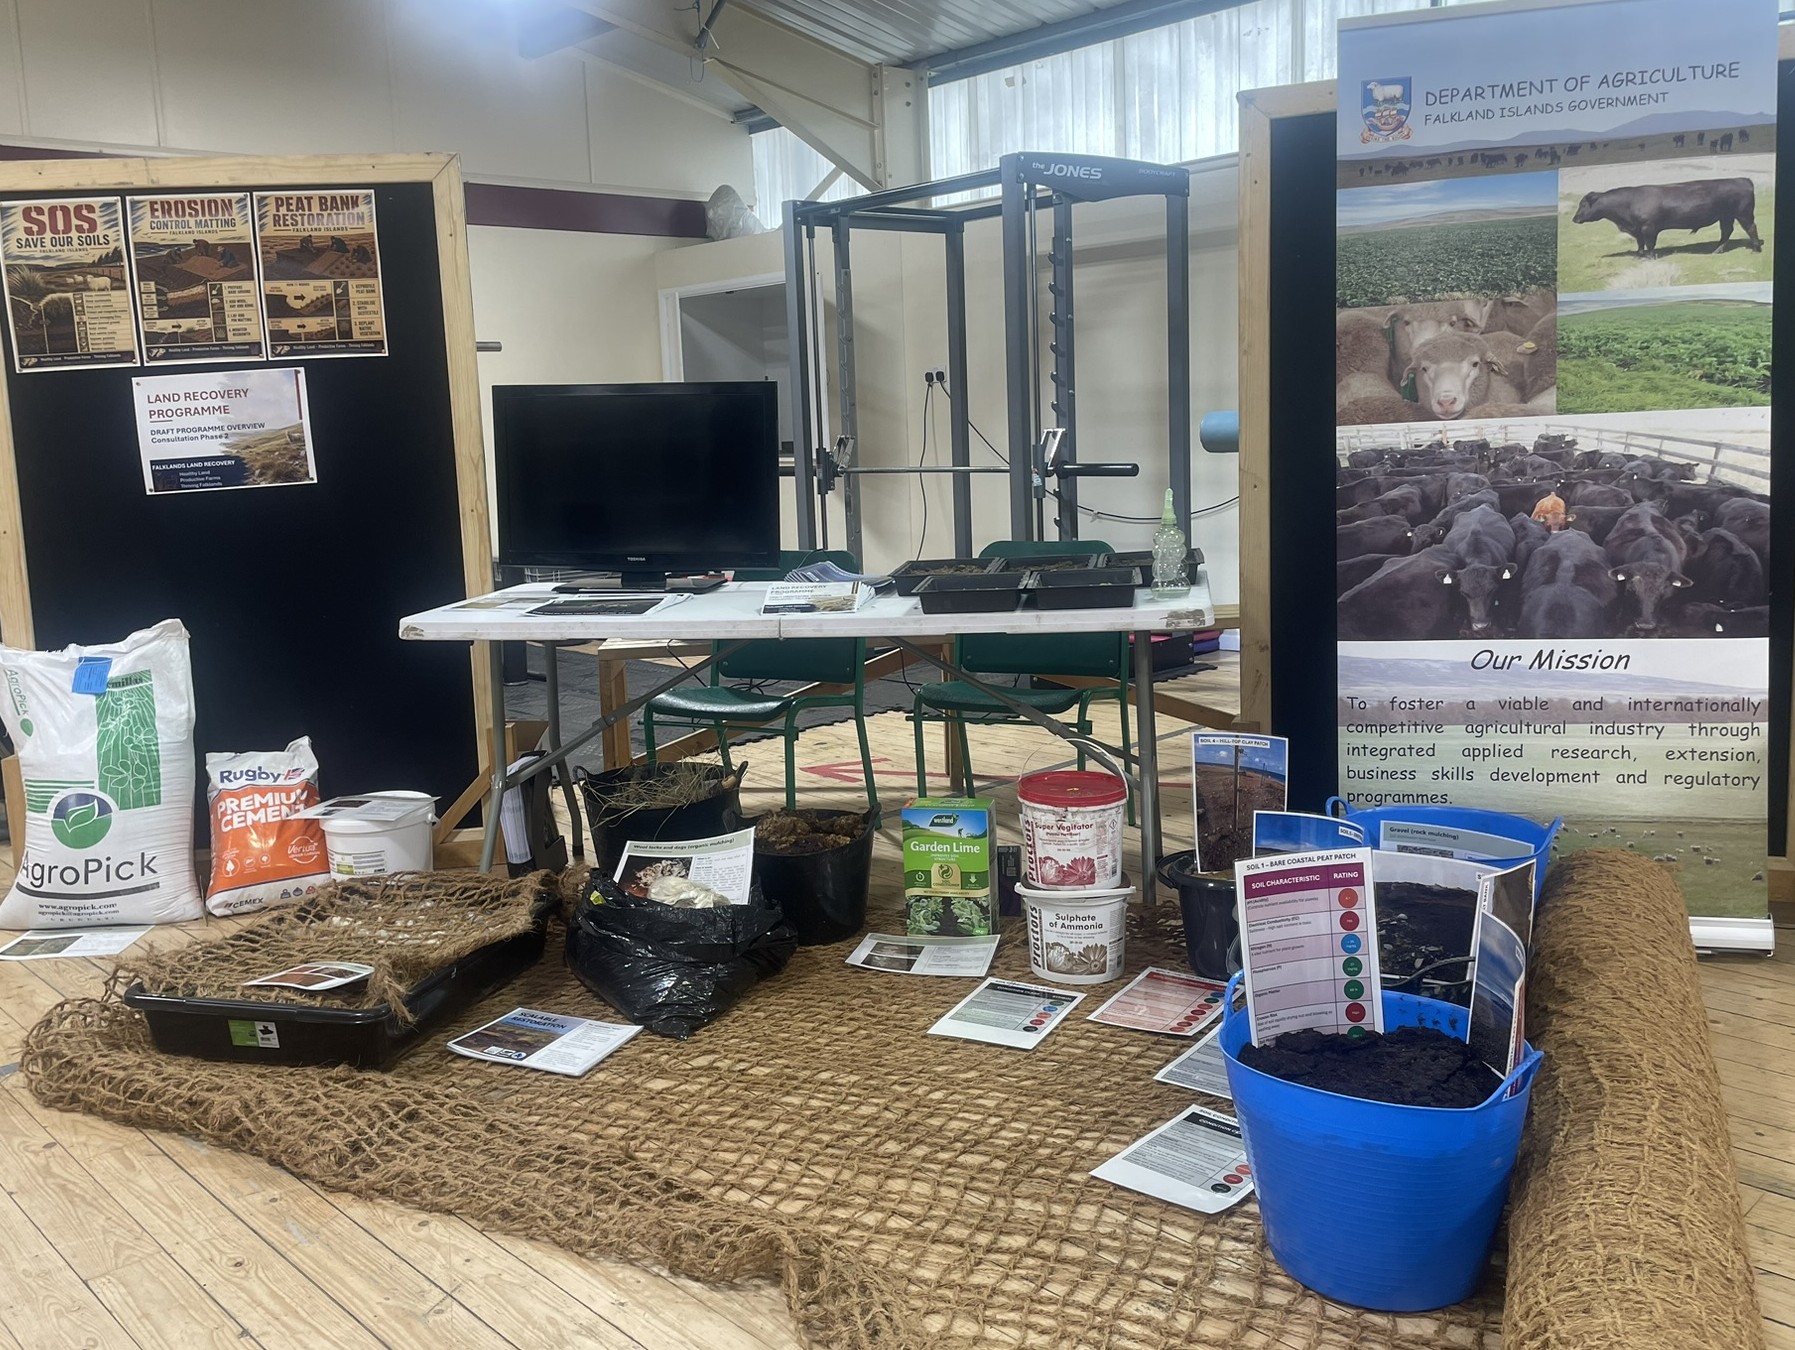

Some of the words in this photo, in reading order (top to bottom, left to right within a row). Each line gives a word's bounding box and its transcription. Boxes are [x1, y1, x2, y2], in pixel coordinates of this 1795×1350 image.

[1425, 78, 1558, 107] DEPARTMENT
[1564, 74, 1591, 92] OF
[1598, 61, 1741, 90] AGRICULTURE
[1424, 108, 1494, 127] FALKLAND
[1500, 102, 1564, 119] ISLANDS
[1568, 92, 1669, 112] GOVERNMENT
[1044, 164, 1102, 179] JONES
[149, 199, 233, 219] EROSION
[275, 197, 313, 212] PEAT
[318, 195, 360, 212] BANK
[22, 204, 98, 236] SOS
[150, 219, 192, 230] CONTROL
[195, 218, 236, 228] MATTING
[273, 212, 365, 227] RESTORATION
[16, 237, 46, 248] SAVE
[51, 235, 73, 247] OUR
[78, 234, 110, 246] SOILS
[147, 393, 181, 404] LAND
[184, 388, 249, 401] RECOVERY
[149, 405, 230, 419] PROGRAMME
[176, 426, 225, 434] PROGRAMME
[227, 422, 266, 431] OVERVIEW
[151, 435, 199, 444] Consultation
[1471, 649, 1521, 670] Our
[1529, 649, 1631, 671] Mission
[106, 677, 143, 688] emillas
[7, 669, 29, 715] AgroPick
[1347, 696, 1367, 710] To
[1390, 696, 1444, 711] foster
[1466, 700, 1475, 710] a
[1498, 696, 1549, 710] viable
[1572, 697, 1603, 711] and
[1628, 697, 1761, 716] internationally
[1347, 720, 1444, 737] competitive
[1465, 720, 1566, 737] agricultural
[1590, 721, 1665, 739] industry
[1688, 722, 1760, 741] through
[1347, 743, 1436, 760] integrated
[1462, 744, 1524, 761] applied
[1551, 746, 1637, 762] research,
[1665, 747, 1761, 764] extension,
[220, 766, 281, 783] Rugby
[1347, 766, 1416, 780] business
[1431, 767, 1474, 781] skills
[1490, 768, 1600, 786] development
[1616, 770, 1647, 784] and
[1664, 772, 1760, 790] regulatory
[1347, 790, 1452, 807] programmes.
[1056, 823, 1093, 832] Vegitator
[1428, 831, 1459, 840] mulching)
[910, 841, 950, 852] Garden
[953, 842, 980, 853] Lime
[20, 851, 158, 888] AgroPick
[1266, 875, 1320, 886] CHARACTERISTIC
[39, 903, 117, 911] www.agropick.com
[233, 898, 264, 908] CEMEX
[1055, 913, 1096, 922] Sulphate
[511, 1016, 567, 1029] RESTORATION
[519, 1012, 558, 1023] SCALABLE
[1199, 1118, 1231, 1132] CONDITION
[1213, 1114, 1238, 1124] CONDITI
